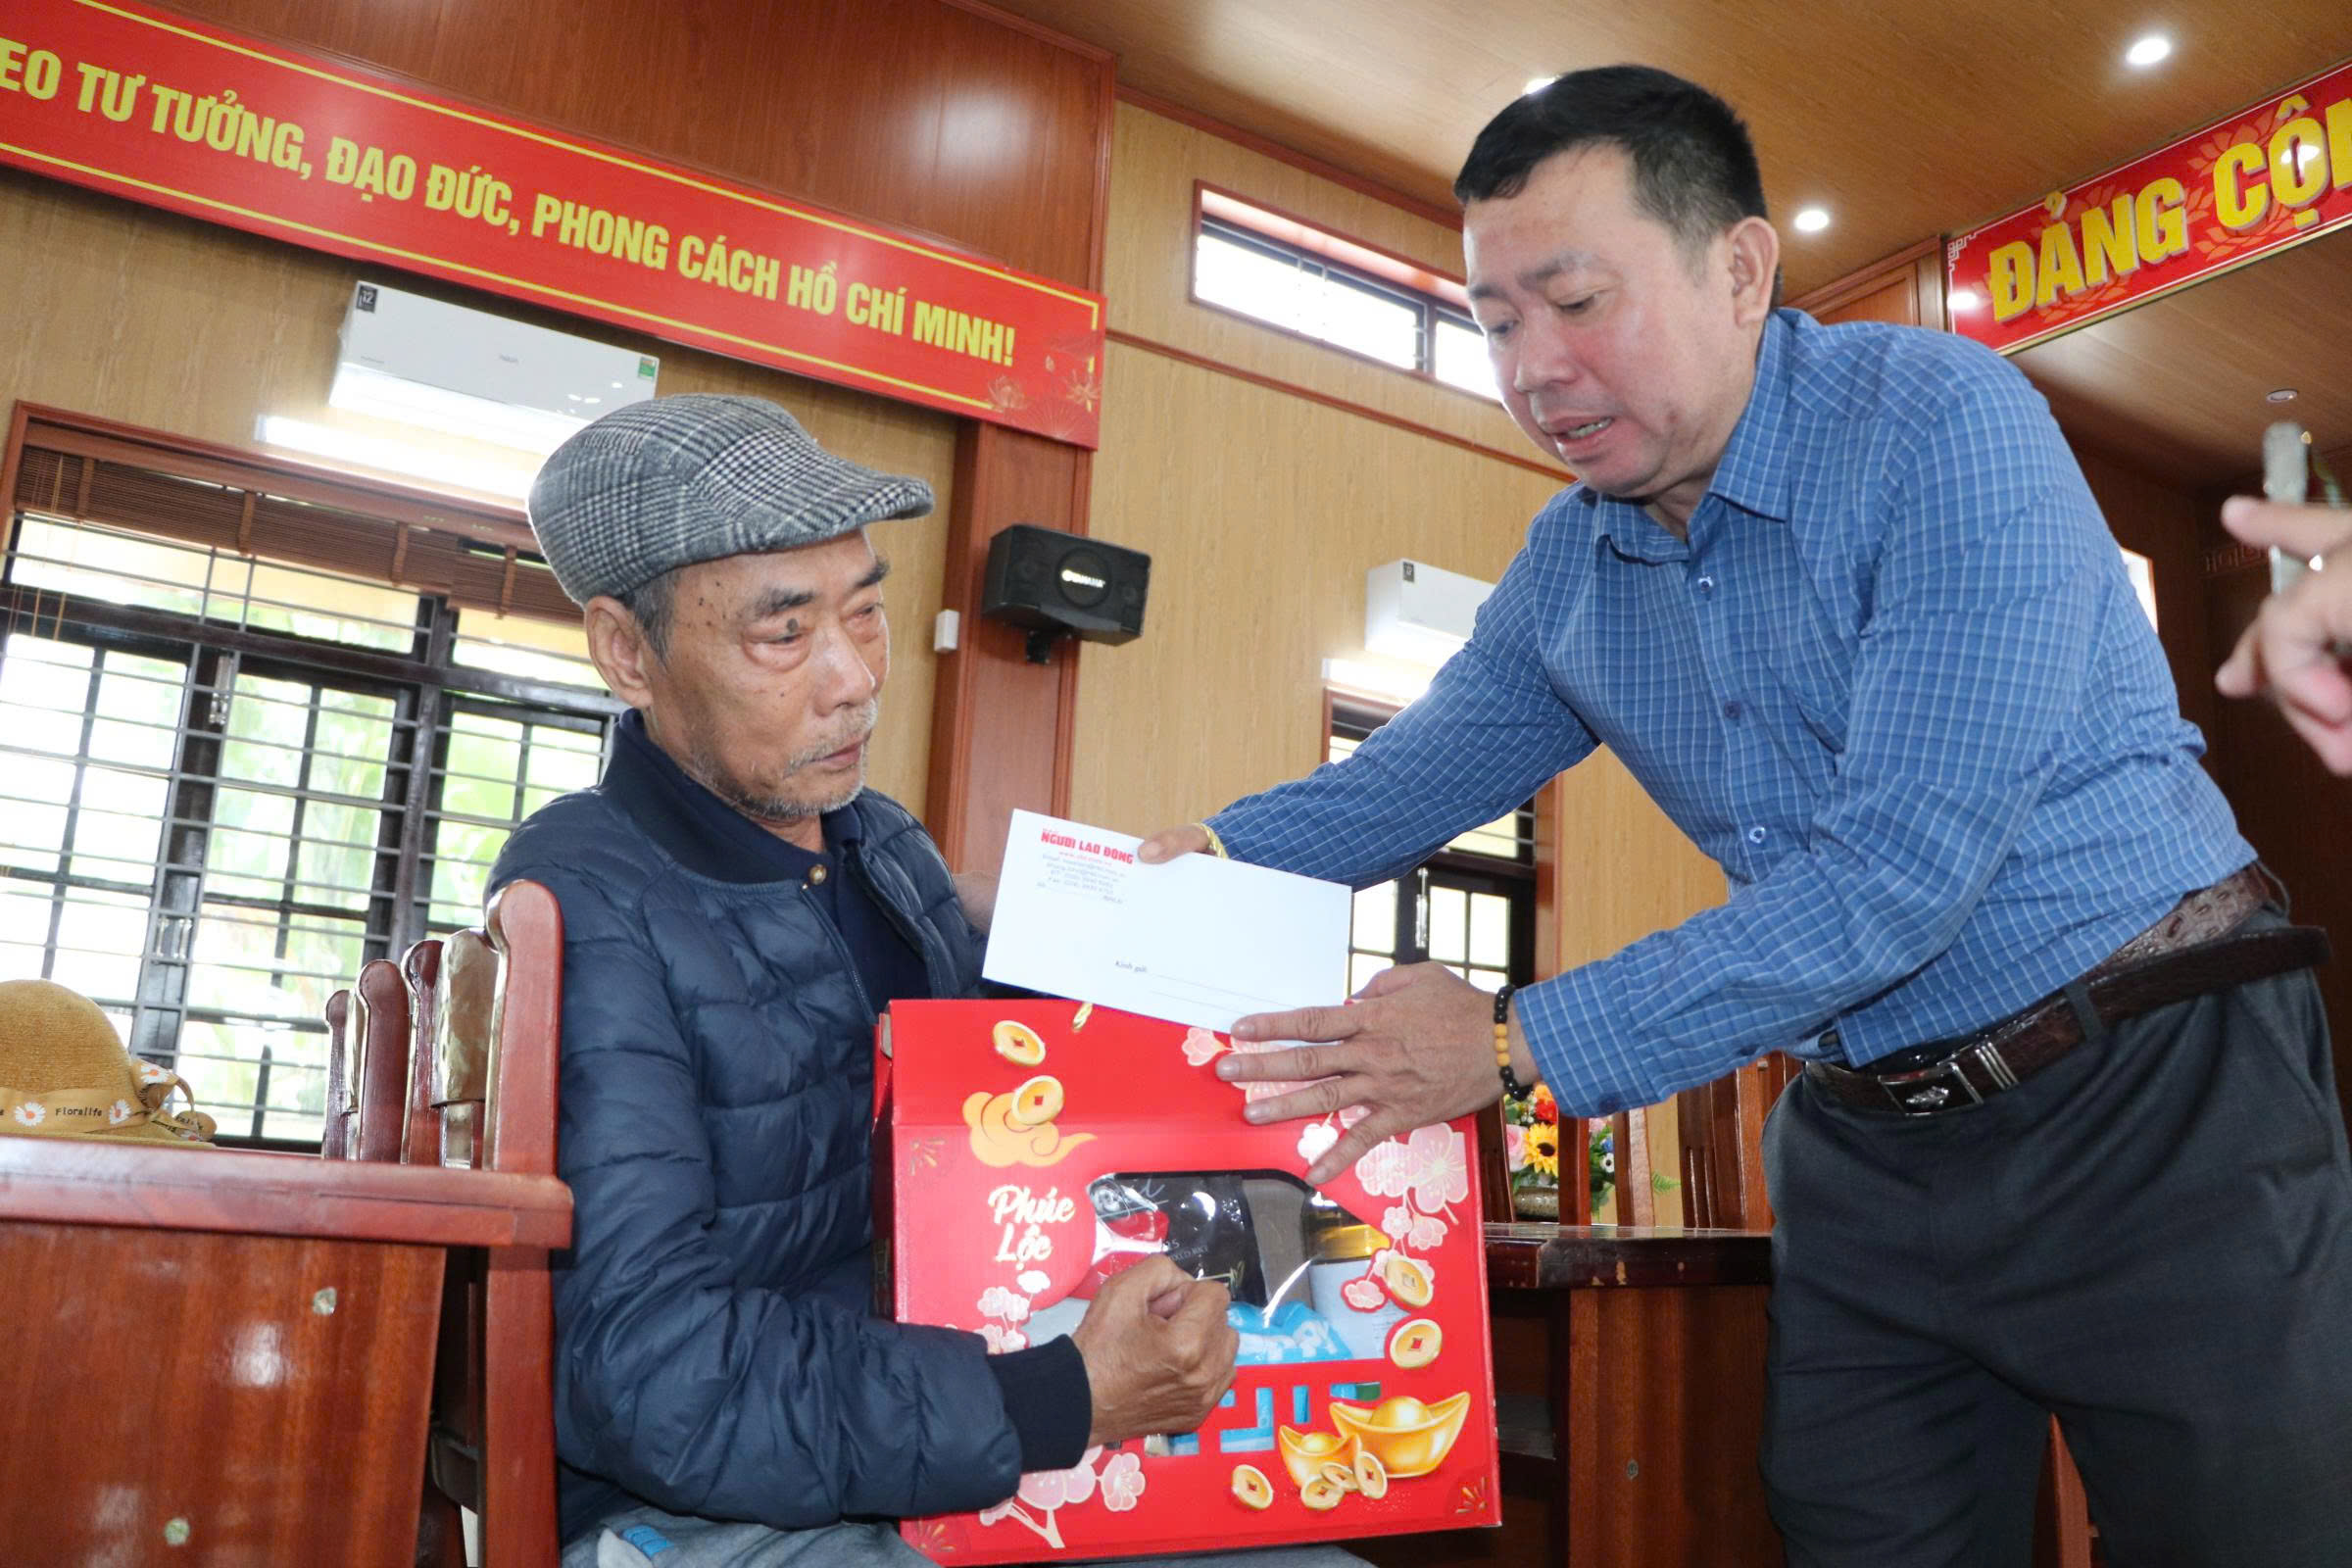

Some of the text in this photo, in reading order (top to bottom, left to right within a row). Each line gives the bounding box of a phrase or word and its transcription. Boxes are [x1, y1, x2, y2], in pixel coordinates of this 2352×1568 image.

[0, 37, 1015, 368] EO TƯ TƯỞNG, ĐẠO ĐỨC, PHONG CÁCH HỒ CHÍ MINH!
[1988, 176, 2190, 323] ĐẢNG
[1078, 839, 1102, 856] LAO
[988, 1184, 1076, 1225] Phúc
[993, 1222, 1054, 1271] Lộc
